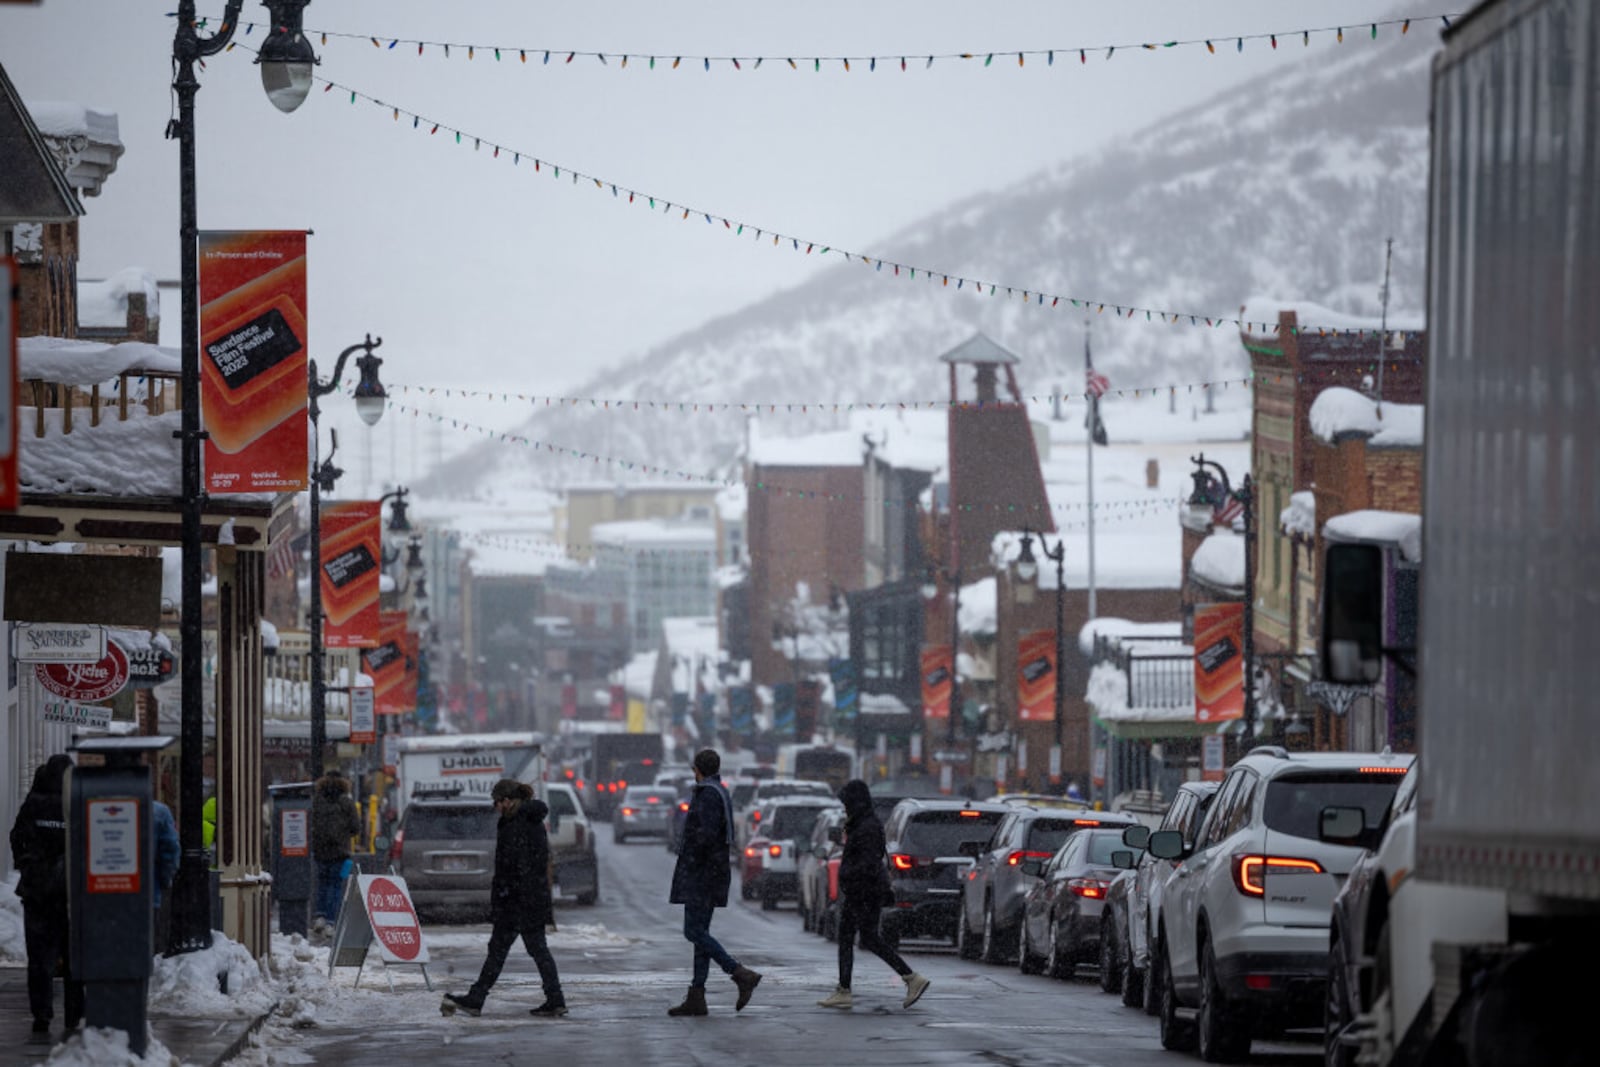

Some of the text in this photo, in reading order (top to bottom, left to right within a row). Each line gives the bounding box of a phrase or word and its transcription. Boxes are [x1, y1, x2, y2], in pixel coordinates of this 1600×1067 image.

[208, 325, 260, 356] Sundance
[215, 326, 275, 367] Film Festival
[222, 355, 249, 377] 2023
[27, 630, 81, 642] SAUNDERS
[32, 639, 85, 650] SAUNDERS
[44, 703, 88, 718] GELATO
[442, 755, 503, 769] U-HAUL
[370, 893, 405, 908] DO NOT
[384, 930, 415, 945] ENTER
